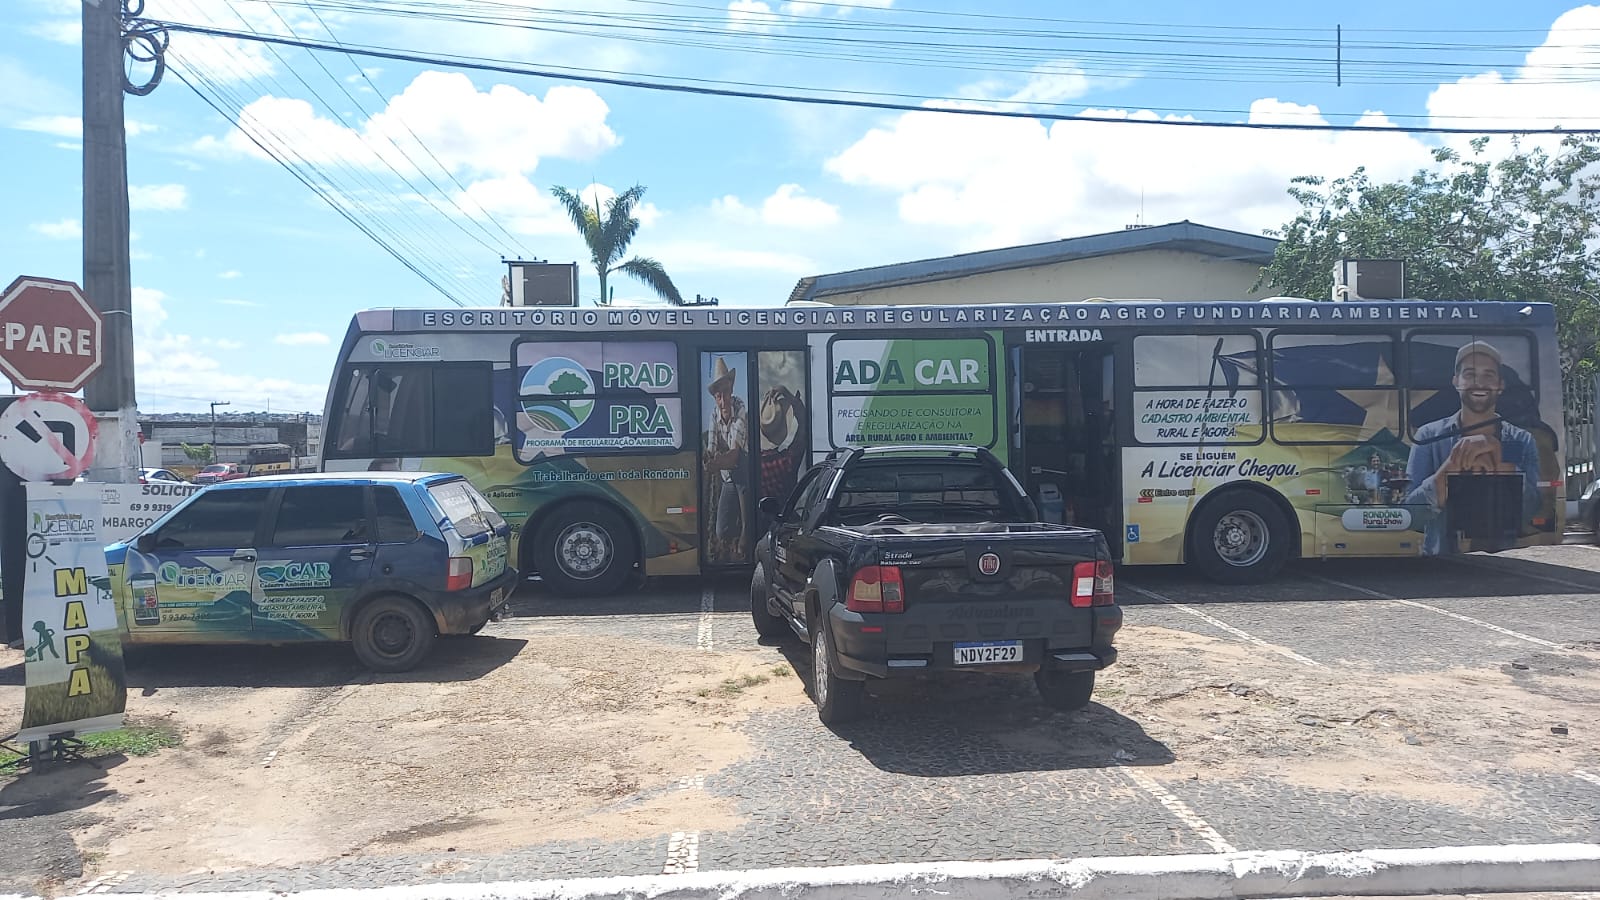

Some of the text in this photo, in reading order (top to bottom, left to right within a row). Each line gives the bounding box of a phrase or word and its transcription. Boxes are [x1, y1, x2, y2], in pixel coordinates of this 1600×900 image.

[423, 304, 1480, 325] ESCRITÓRIO MÓVEL LICENCIAR REGULARIZAÇÃO AGRO FUNDIÁRIA AMBIENTAL
[5, 322, 91, 356] PARE
[1025, 329, 1103, 343] ENTRADA
[603, 362, 674, 388] PRAD
[835, 359, 980, 385] ADA CAR
[1146, 398, 1247, 409] A HORA DE FAZER O
[837, 407, 982, 418] PRECISANDO DE CONSULTORIA
[1141, 412, 1251, 424] CADASTRO AMBIENTAL
[610, 405, 674, 434] PRA
[858, 419, 962, 431] E REGULARIZAÇÃO NA
[845, 432, 974, 442] ÁREA RURAL AGRO E AMBIENTAL?
[1157, 427, 1188, 438] RURAL
[526, 436, 674, 448] PROGRAMA DE REGULARIZAÇÃO AMBIENTAL
[1180, 452, 1236, 461] SE LIGUEM
[534, 469, 690, 480] Trabalhando em toda Rondônia
[1141, 457, 1300, 481] A Licenciar Chegou.
[130, 503, 142, 512] 69
[143, 503, 150, 512] 9
[1363, 509, 1402, 518] RONDÔNIA
[884, 551, 913, 559] Strada
[285, 562, 332, 581] CAR
[54, 567, 91, 697] MAPA
[960, 647, 1017, 663] NDY2F29
